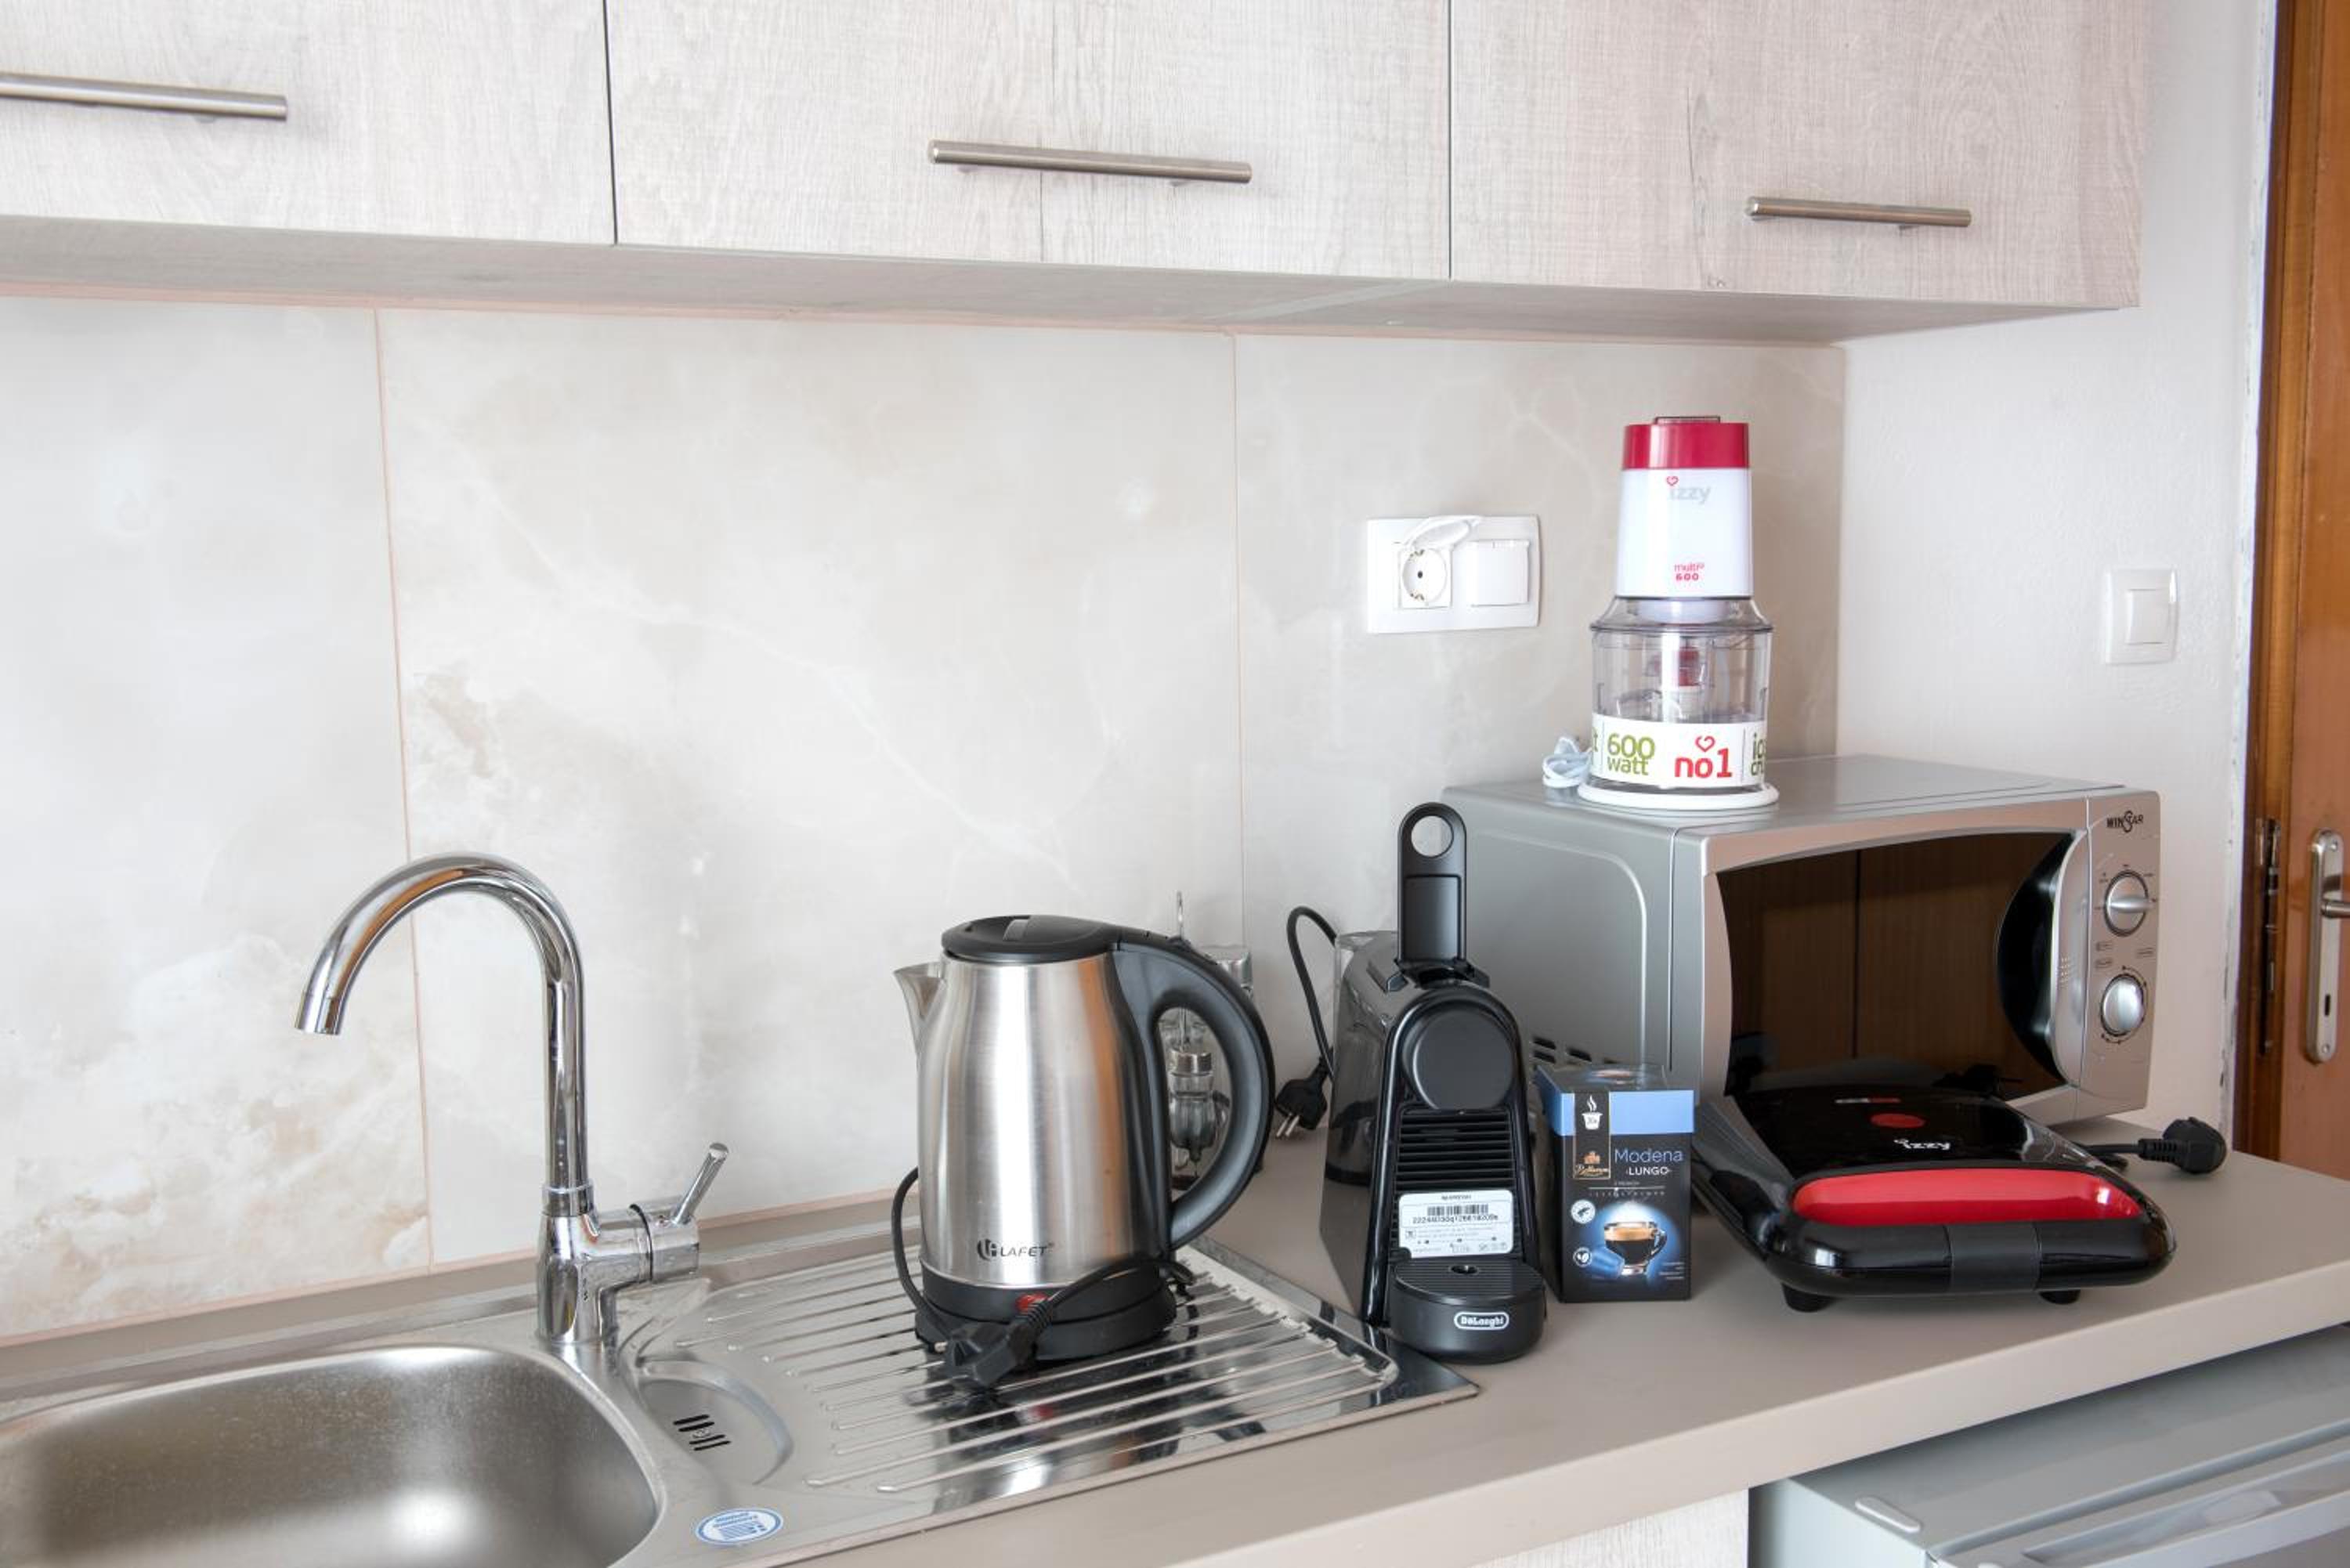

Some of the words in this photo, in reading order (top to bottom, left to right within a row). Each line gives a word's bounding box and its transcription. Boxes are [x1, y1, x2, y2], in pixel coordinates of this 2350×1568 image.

[1607, 732, 1655, 760] 600
[1607, 756, 1649, 775] watt
[1674, 748, 1733, 779] no1
[1614, 1148, 1683, 1164] Modena
[1629, 1166, 1670, 1176] LUNGO
